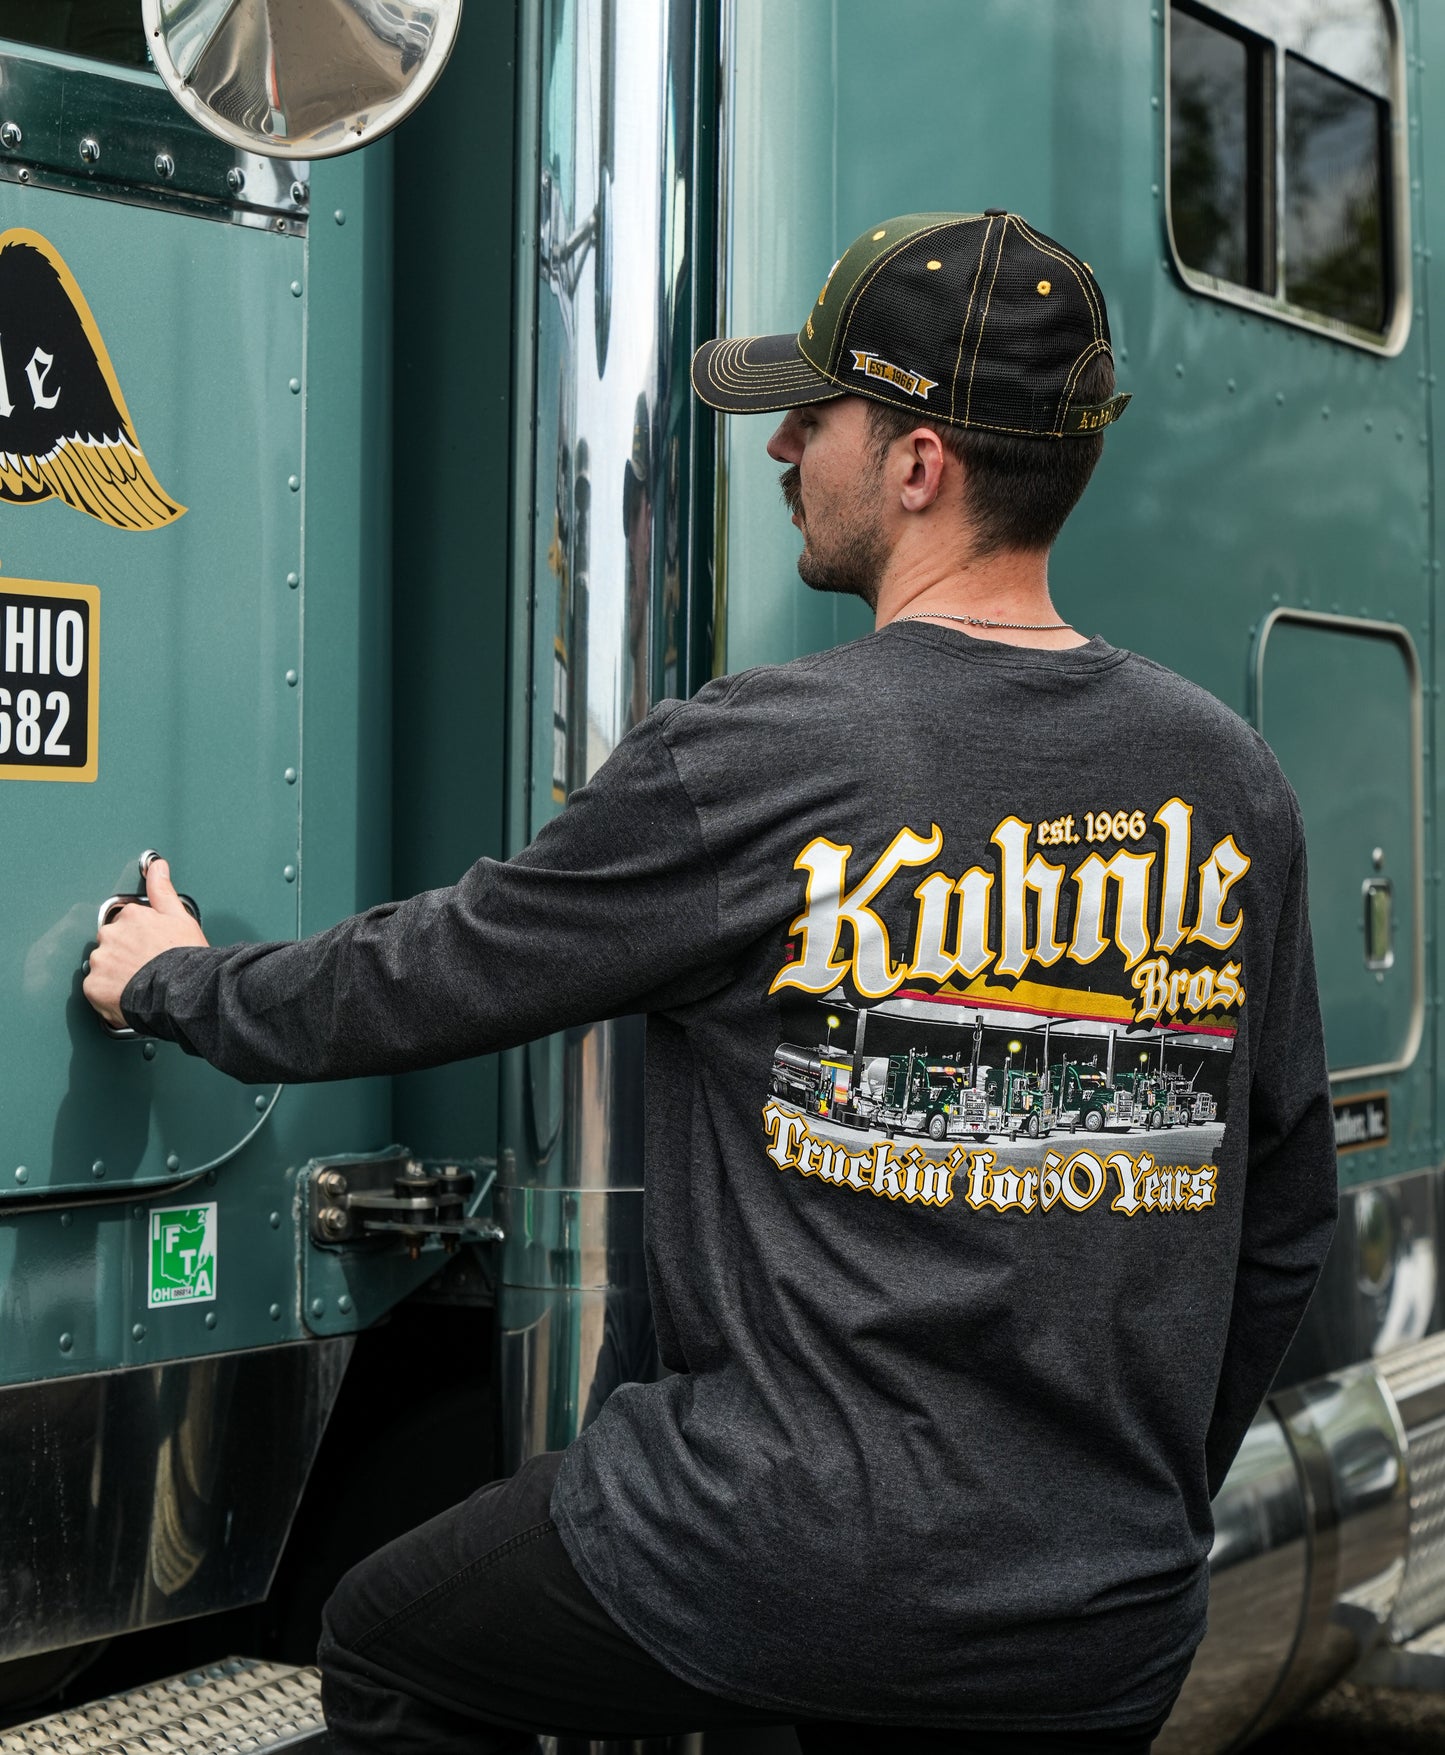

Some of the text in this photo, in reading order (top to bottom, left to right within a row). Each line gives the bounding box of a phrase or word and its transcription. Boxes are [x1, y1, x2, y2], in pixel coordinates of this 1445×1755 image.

[869, 361, 915, 391] EST. 1966
[5, 605, 84, 677] HIO
[1037, 811, 1147, 846] est. 1966
[768, 797, 1251, 998] Kuhnle
[1132, 956, 1246, 1021] Bros.
[761, 1103, 1219, 1213] Truckin' for 60 Years
[153, 1288, 170, 1302] OH
